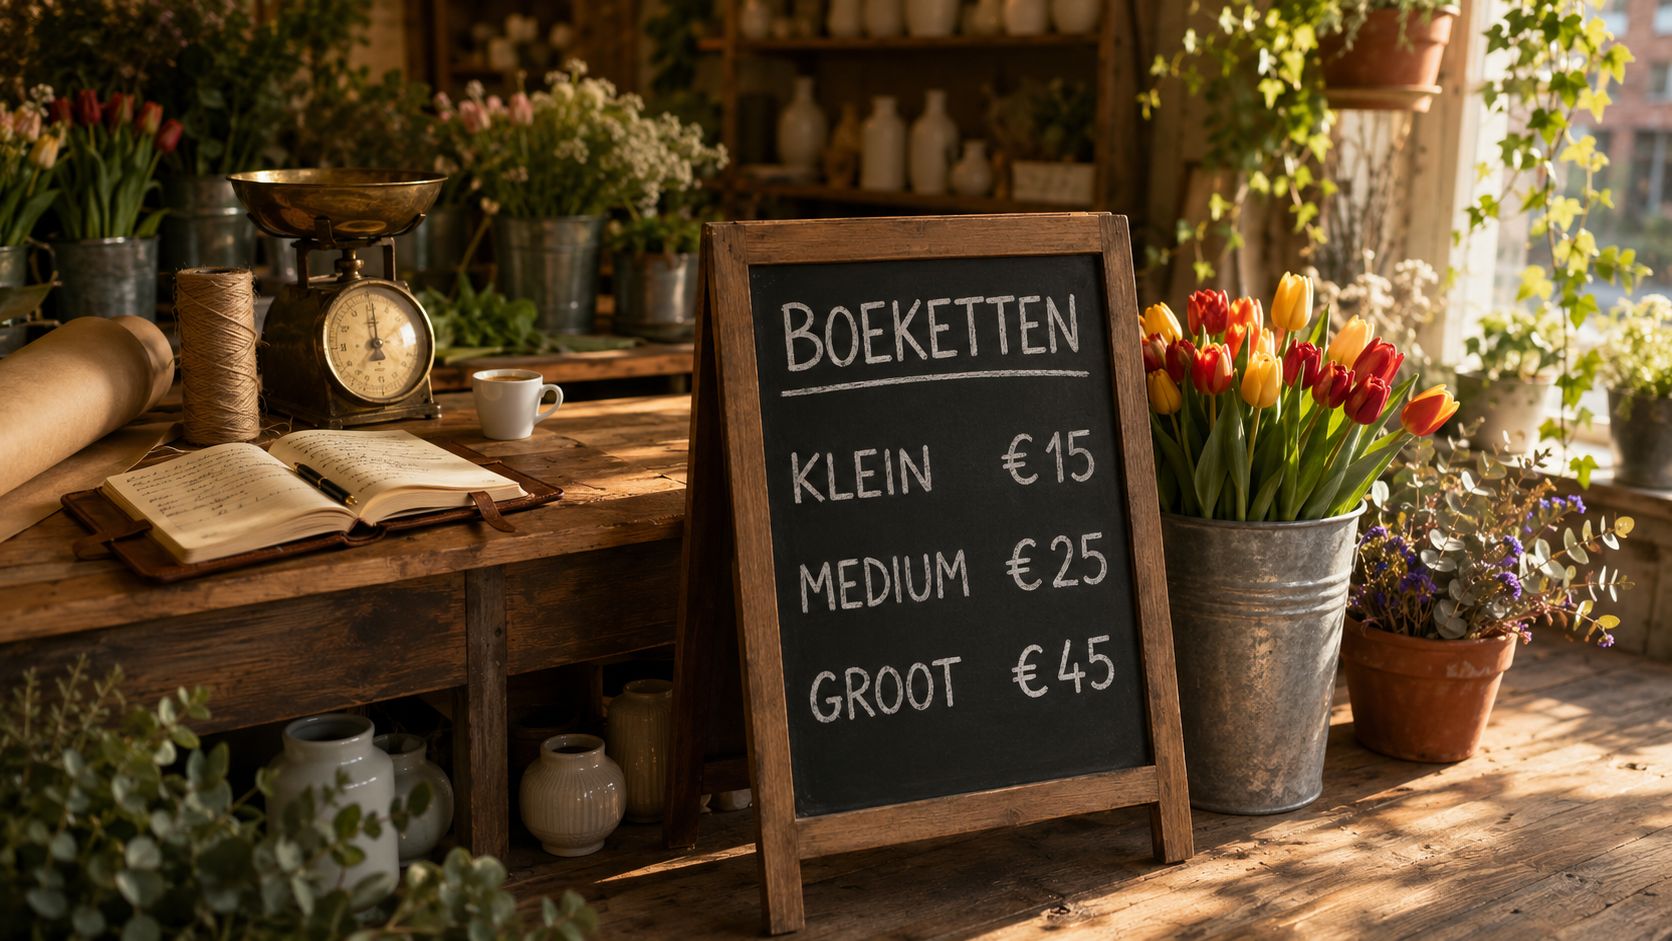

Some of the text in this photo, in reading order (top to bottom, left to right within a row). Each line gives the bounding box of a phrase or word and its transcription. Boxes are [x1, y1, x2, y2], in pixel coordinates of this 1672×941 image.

[782, 295, 1079, 371] BOEKETTEN
[793, 446, 931, 503] KLEIN
[801, 550, 969, 613] MEDIUM
[811, 657, 961, 722] GROOT
